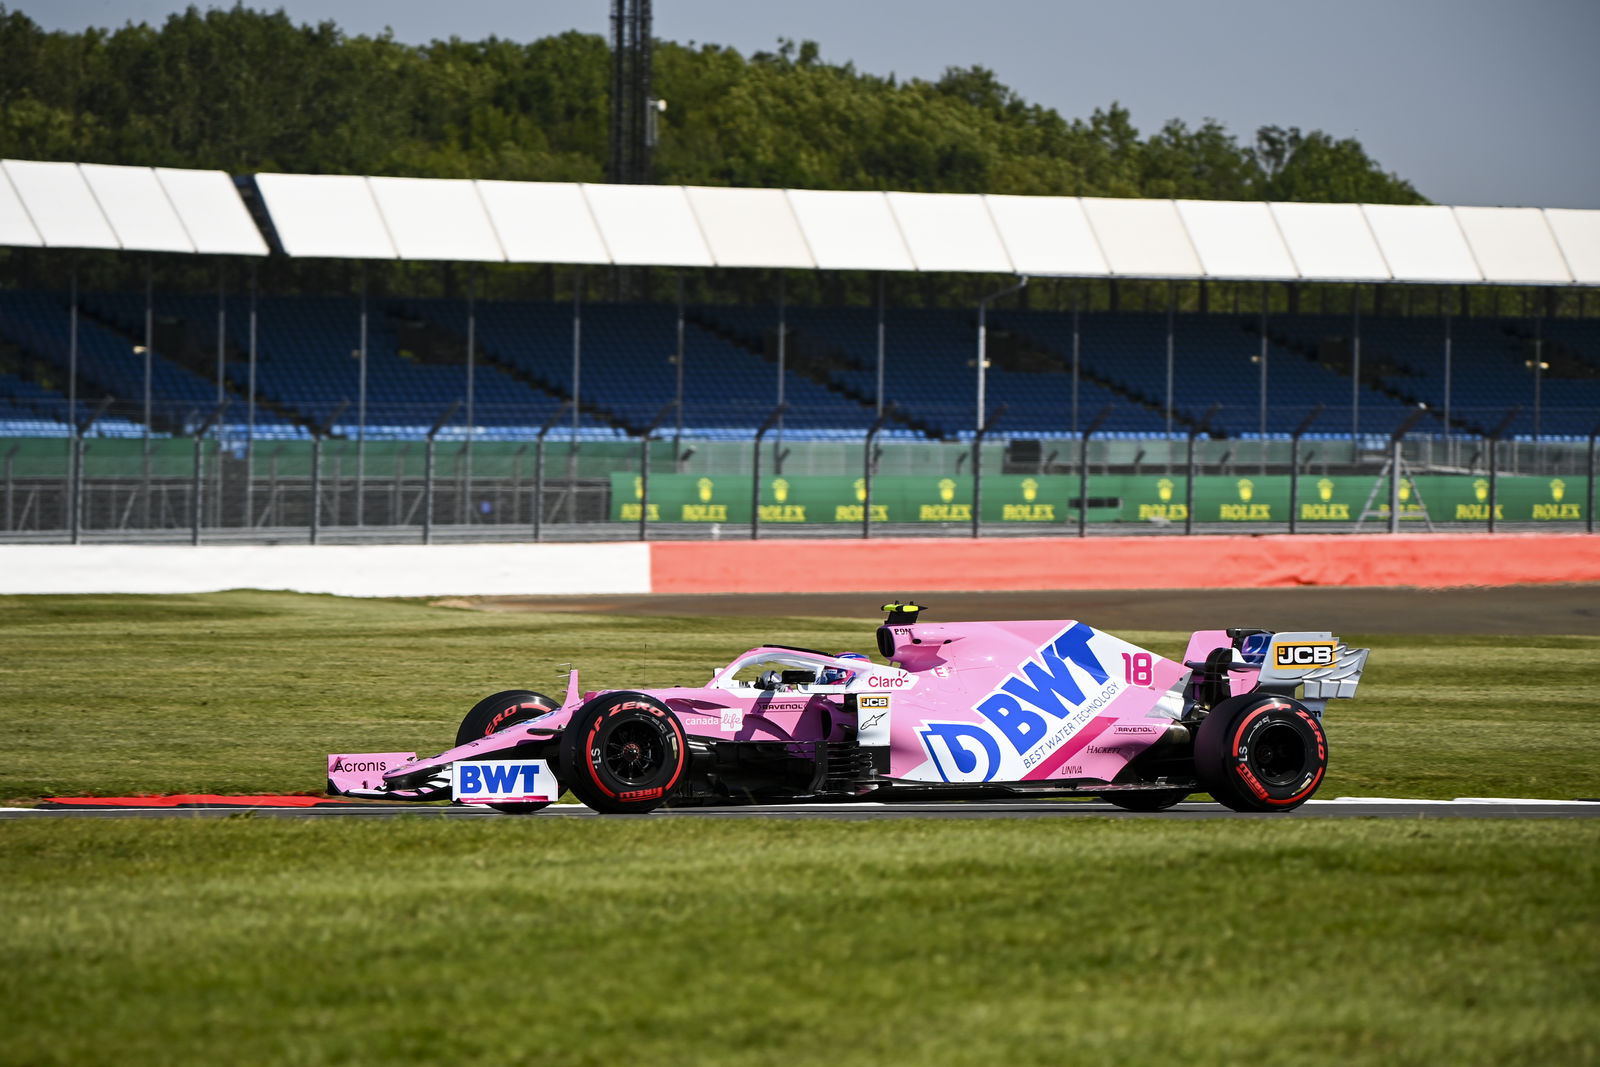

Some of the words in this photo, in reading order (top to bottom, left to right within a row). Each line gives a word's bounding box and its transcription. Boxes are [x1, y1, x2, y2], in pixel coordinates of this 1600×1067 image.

[682, 505, 727, 521] ROLEX
[919, 505, 971, 520] ROLEX
[1003, 505, 1055, 520] ROLEX
[1220, 504, 1271, 519] ROLEX
[1302, 504, 1349, 519] ROLEX
[1532, 504, 1580, 519] ROLEX
[1278, 646, 1332, 664] JCB
[1121, 652, 1153, 687] 18
[868, 676, 903, 688] Claro
[976, 622, 1110, 756] BWT
[608, 701, 666, 718] ZERO
[862, 698, 887, 707] JCB
[484, 704, 518, 736] ERO
[685, 717, 719, 726] canada
[1023, 745, 1046, 769] BEST
[1045, 722, 1076, 749] WATER
[1072, 681, 1120, 726] TECHNOLOGY
[1295, 709, 1325, 761] ZERO
[333, 759, 387, 773] Acronis
[460, 764, 540, 794] BWT
[618, 786, 664, 802] PIRELLI
